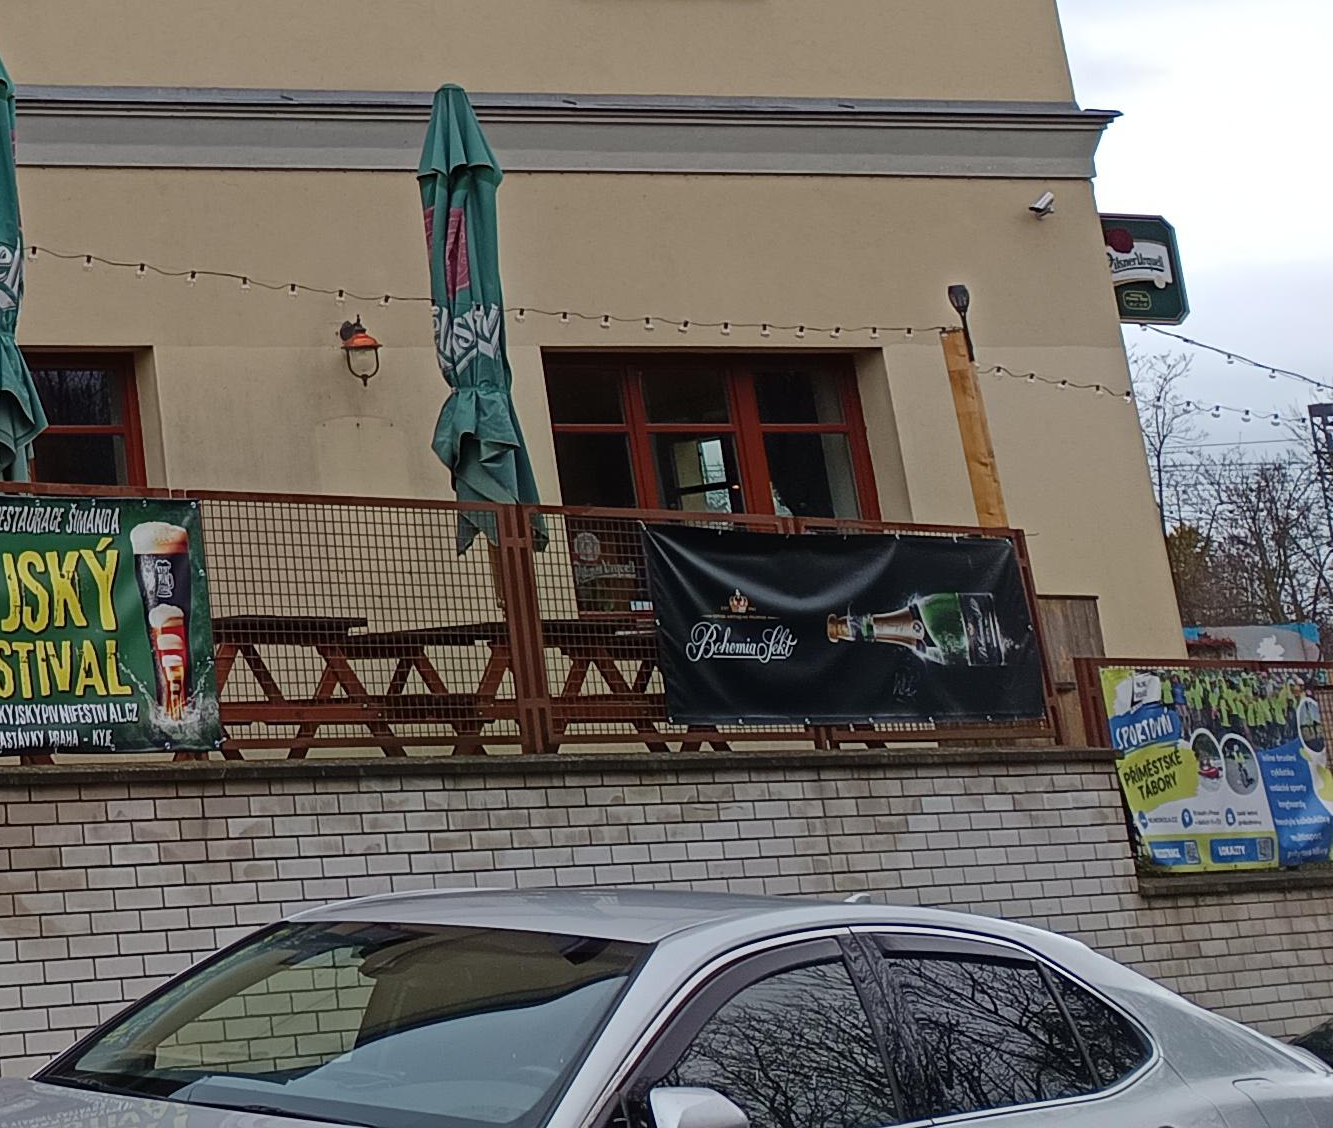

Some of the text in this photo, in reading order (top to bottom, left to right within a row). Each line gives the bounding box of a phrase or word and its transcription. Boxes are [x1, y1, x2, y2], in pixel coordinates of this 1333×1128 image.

[65, 503, 121, 535] ŠIMANDA
[686, 622, 797, 663] Bohemia Sekt
[1115, 707, 1174, 751] SPORTOVNÍ
[1123, 745, 1183, 788] PŘÍMĚSTSKÉ
[1137, 772, 1178, 800] TÁBORY
